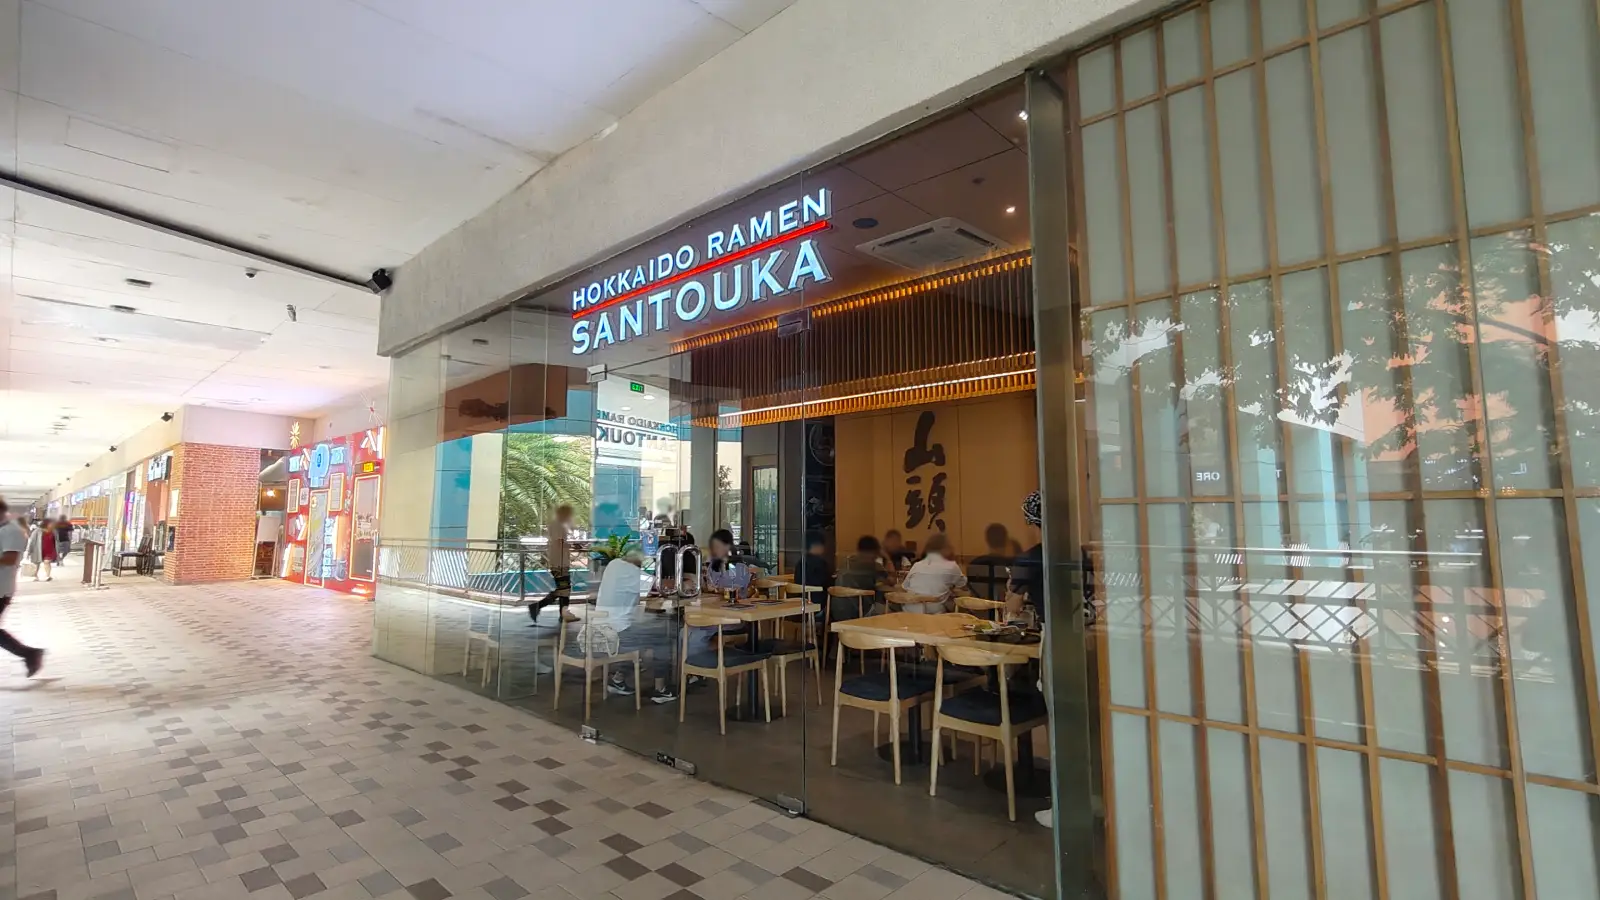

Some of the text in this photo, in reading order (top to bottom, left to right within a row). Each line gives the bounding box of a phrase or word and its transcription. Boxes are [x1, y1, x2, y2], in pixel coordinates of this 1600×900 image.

[571, 187, 830, 311] HOKKAIDO RAMEN
[571, 238, 831, 356] SANTOUKA
[903, 410, 947, 533] 山頭
